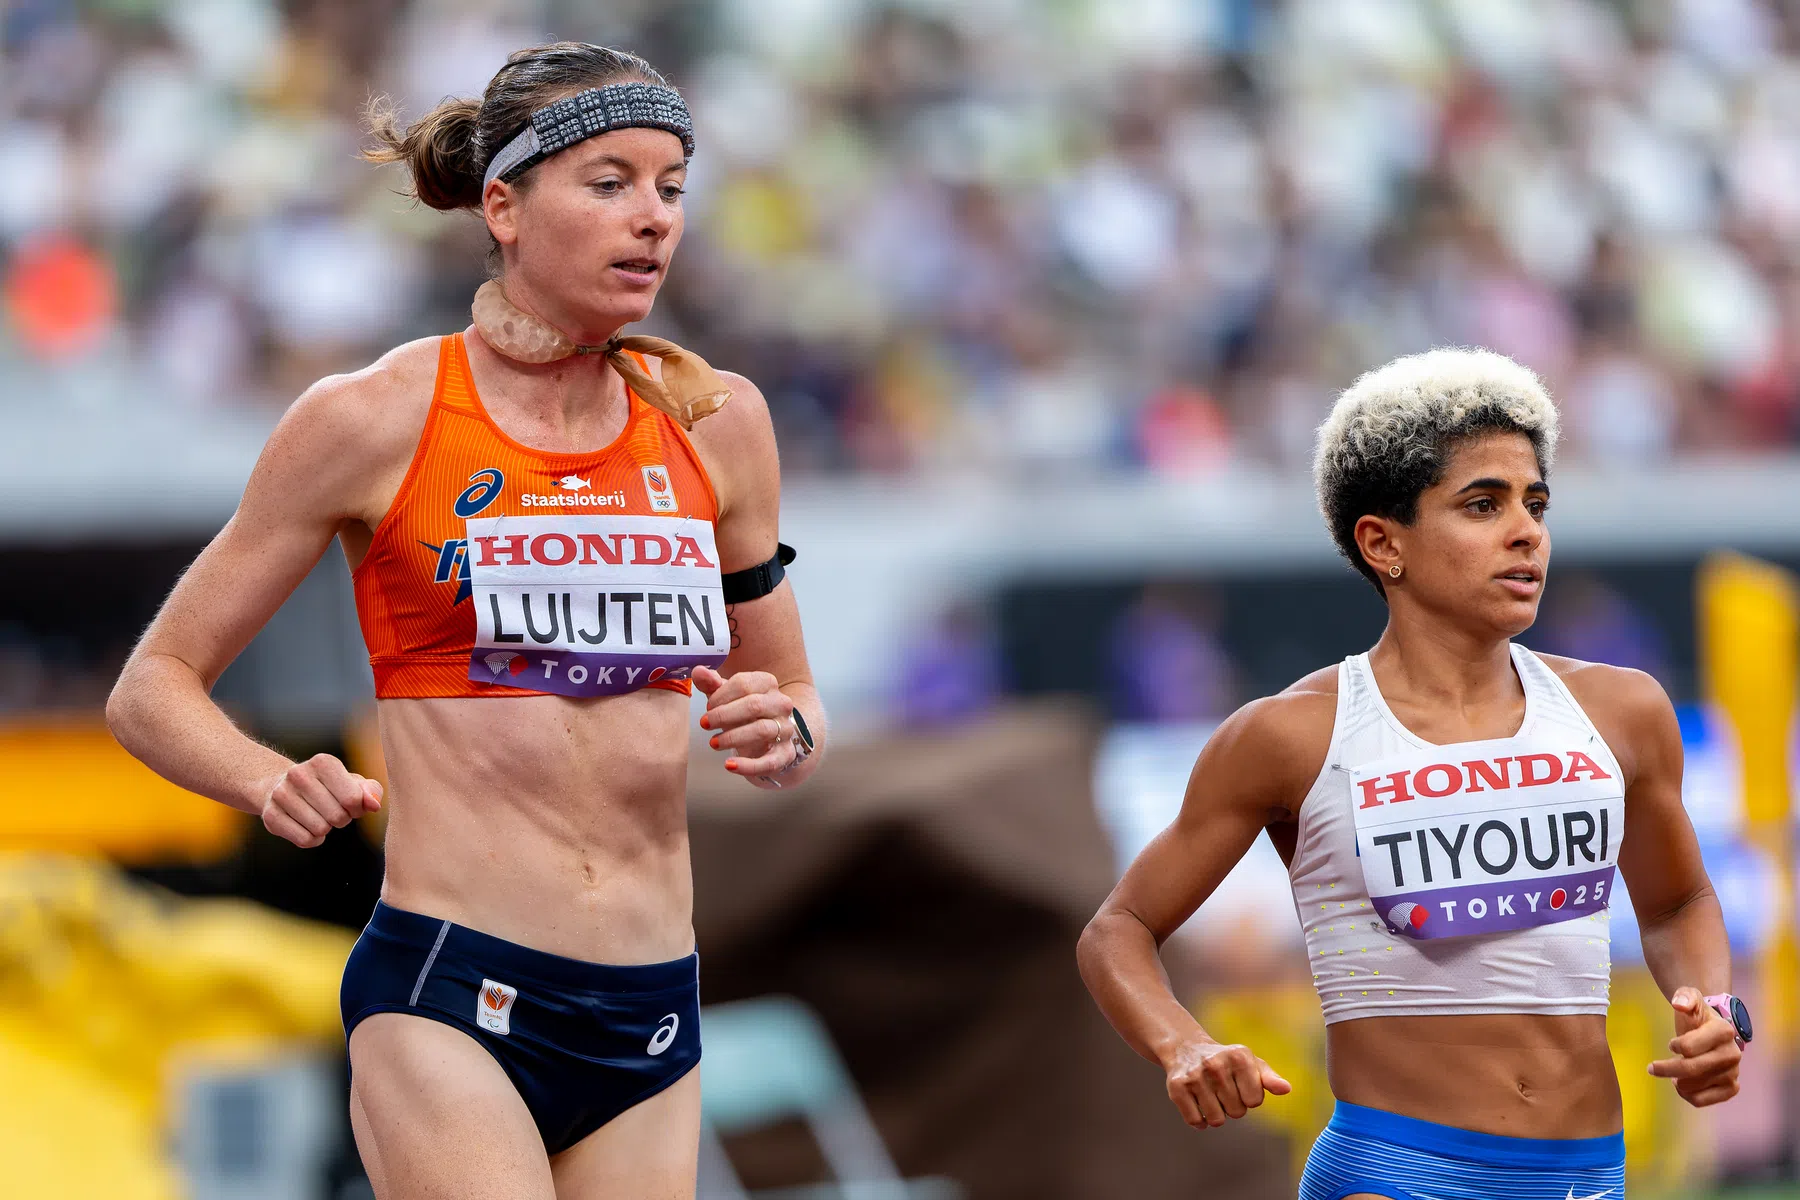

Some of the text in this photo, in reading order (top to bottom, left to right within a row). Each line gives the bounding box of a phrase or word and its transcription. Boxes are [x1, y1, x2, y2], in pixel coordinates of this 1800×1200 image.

[521, 490, 626, 508] Staatsloterij
[474, 533, 715, 569] HONDA
[489, 592, 715, 646] LUIJTEN
[1357, 751, 1612, 810] HONDA
[1373, 808, 1608, 888] TIYOURI
